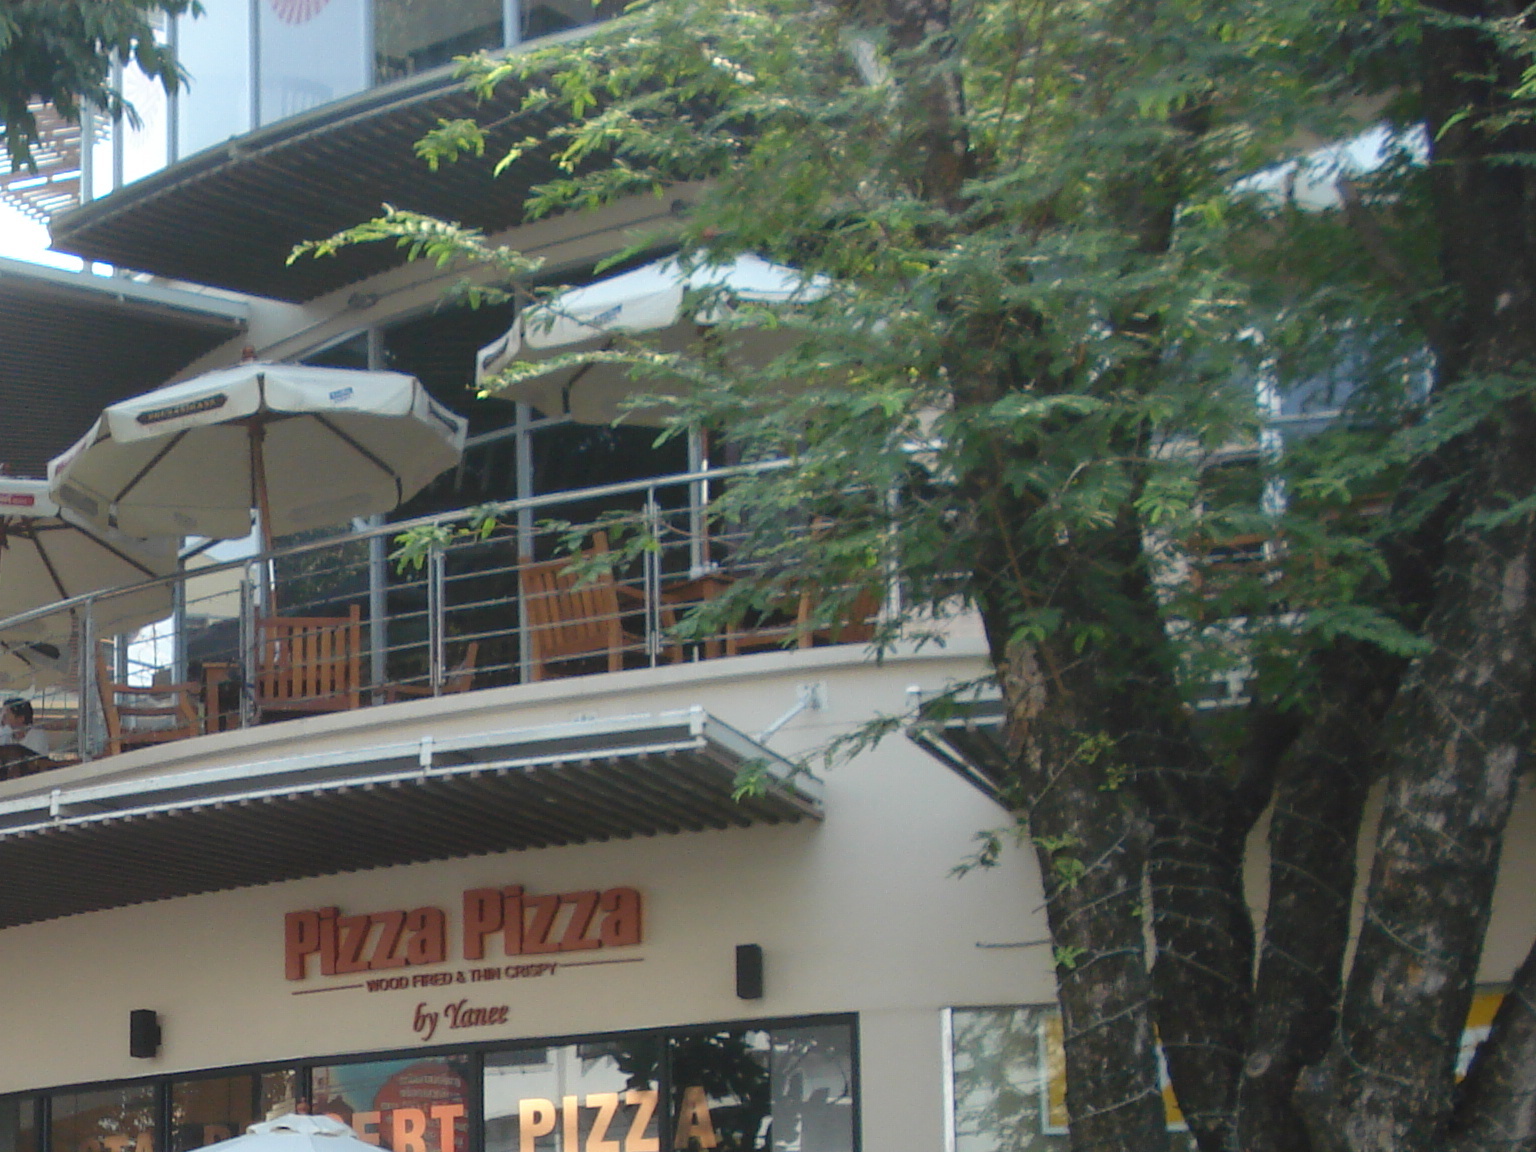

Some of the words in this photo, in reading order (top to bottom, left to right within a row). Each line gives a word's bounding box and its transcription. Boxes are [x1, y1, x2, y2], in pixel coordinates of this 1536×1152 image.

[285, 906, 447, 980] Pizza
[463, 884, 642, 961] Pizza
[367, 976, 409, 992] WOOD
[412, 971, 452, 989] FIRED
[456, 970, 465, 985] &
[470, 967, 501, 983] THIN
[505, 962, 557, 979] CRISPY
[413, 1002, 439, 1041] by
[444, 1000, 510, 1029] Yanee
